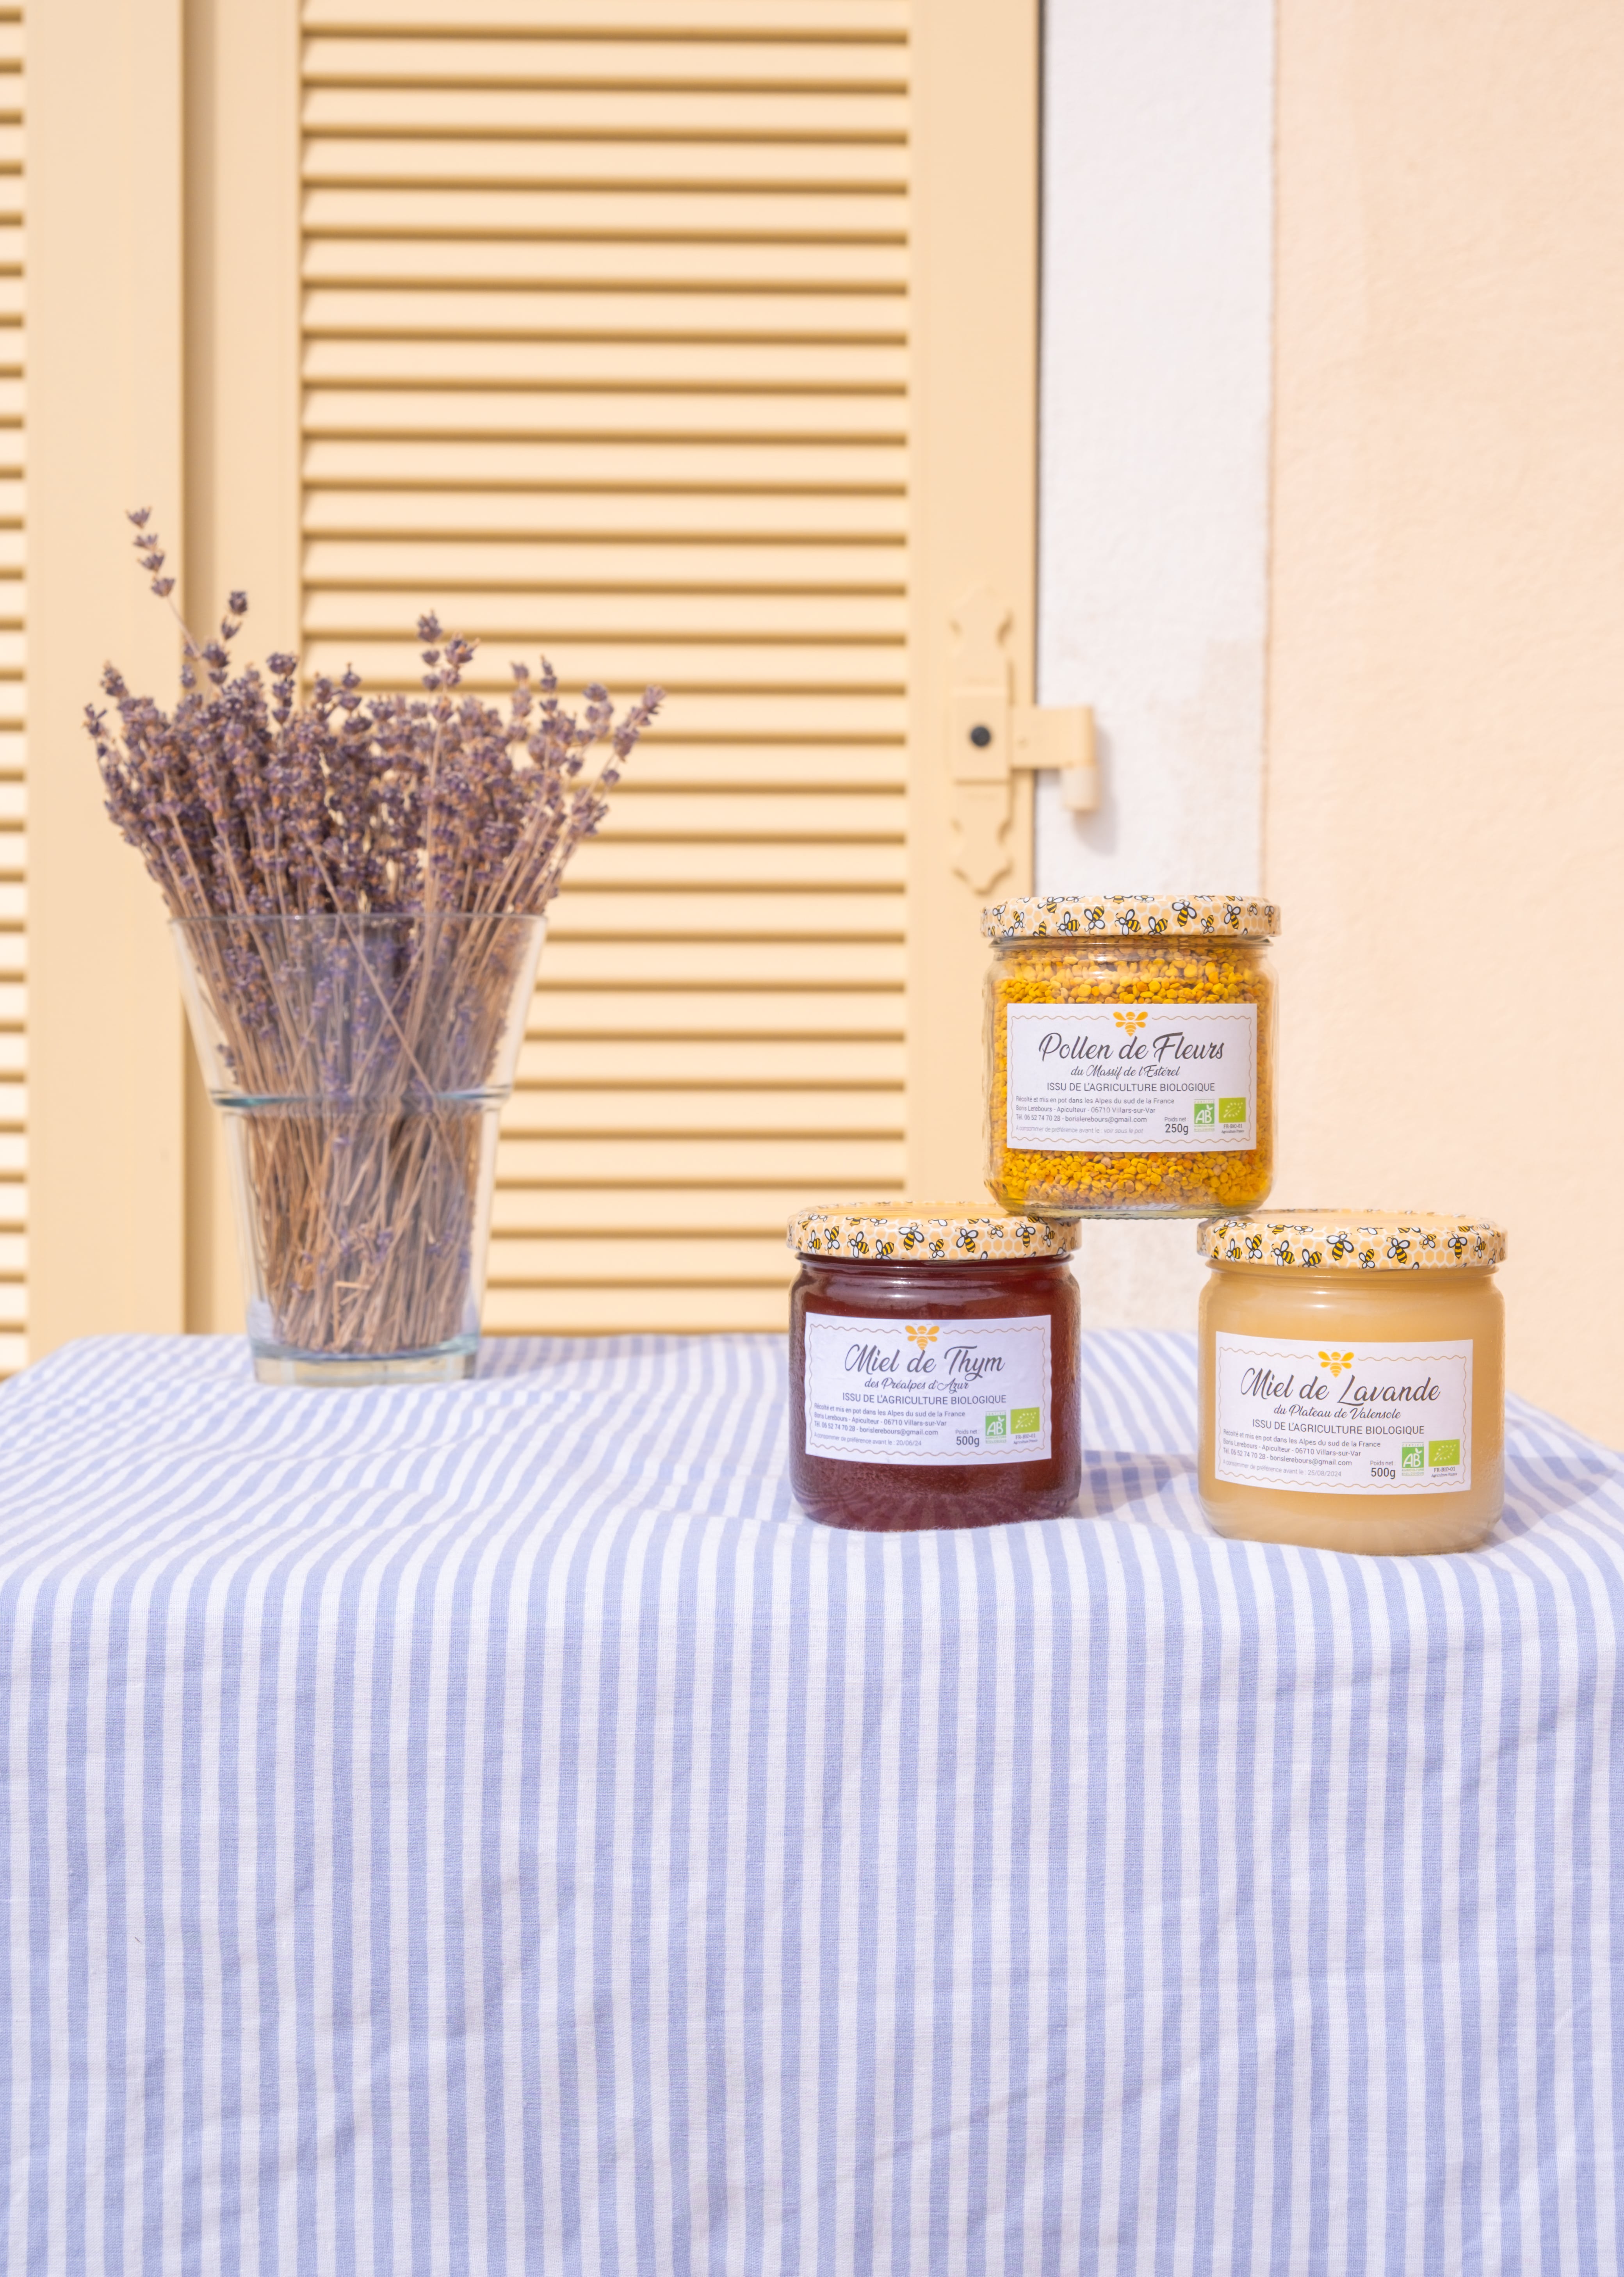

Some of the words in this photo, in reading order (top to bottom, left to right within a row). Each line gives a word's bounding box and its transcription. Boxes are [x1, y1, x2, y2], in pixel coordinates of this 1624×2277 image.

[1039, 1033, 1113, 1061] Pollen
[1119, 1036, 1149, 1059] de
[1153, 1032, 1224, 1063] Fleurs
[1071, 1066, 1084, 1075] du
[1086, 1065, 1122, 1080] Massif
[1124, 1066, 1136, 1076] de
[1139, 1065, 1180, 1077] l'Estérel
[1047, 1082, 1066, 1091] ISSU
[1084, 1083, 1157, 1091] L'AGRICULTURE
[1160, 1083, 1215, 1092] BIOLOGIQUE
[1196, 1110, 1212, 1123] AB
[1165, 1123, 1188, 1135] 250g
[845, 1344, 900, 1375] Miel
[907, 1349, 936, 1373] de
[944, 1346, 1005, 1382] Thym
[865, 1378, 879, 1388] des
[881, 1378, 926, 1392] Préalpes
[928, 1377, 970, 1394] d'Azur
[1241, 1368, 1294, 1399] Miel
[1299, 1376, 1329, 1400] de
[1337, 1375, 1441, 1406] Lavande
[843, 1392, 860, 1402] ISSU
[864, 1394, 874, 1403] DE
[878, 1395, 948, 1405] L'AGRICULTURE
[951, 1395, 1006, 1405] BIOLOGIQUE
[1274, 1405, 1287, 1414] du
[1289, 1405, 1332, 1417] Plateau
[1334, 1408, 1347, 1418] de
[1350, 1407, 1401, 1419] Valensole
[860, 1426, 938, 1436] borislerebours@gmail.com
[987, 1422, 1003, 1435] AB
[1223, 1429, 1238, 1437] Récolté
[1253, 1419, 1271, 1429] ISSU
[1275, 1422, 1286, 1430] DE
[1289, 1422, 1362, 1434] L'AGRICULTURE
[1366, 1426, 1424, 1435] BIOLOGIQUE
[956, 1436, 979, 1447] 500g
[1234, 1440, 1257, 1449] Lerebours
[1262, 1444, 1290, 1453] Apiculteur
[1270, 1454, 1352, 1466] borislerebours@gmail.com
[1403, 1453, 1421, 1467] AB
[1371, 1468, 1395, 1479] 500g
